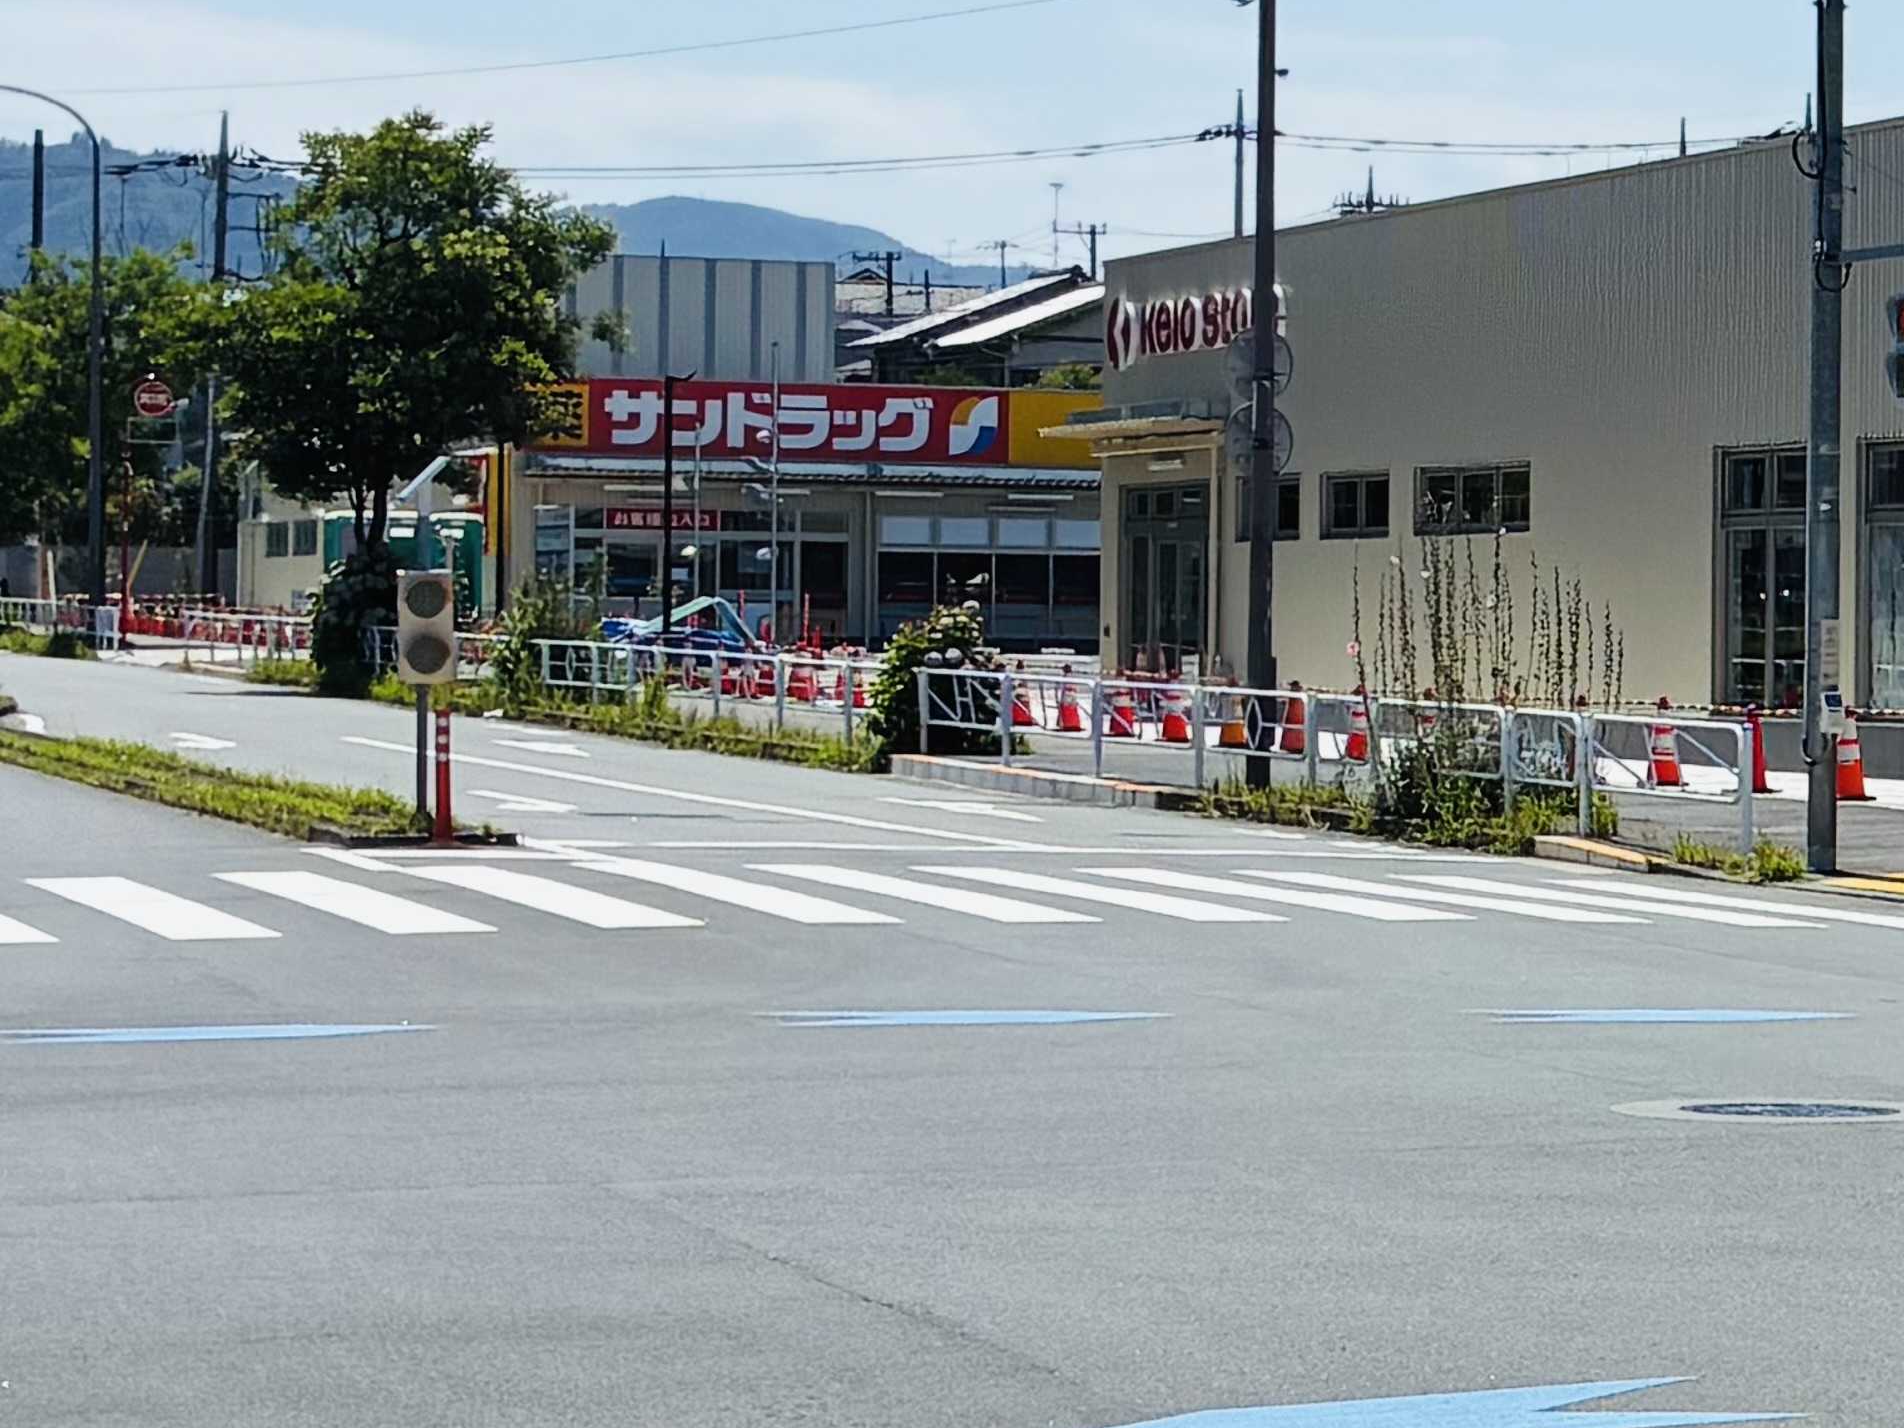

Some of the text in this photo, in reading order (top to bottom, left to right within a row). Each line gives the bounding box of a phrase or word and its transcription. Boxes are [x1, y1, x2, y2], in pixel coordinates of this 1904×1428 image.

[1202, 284, 1280, 348] sto
[604, 389, 934, 453] サンドラッグ
